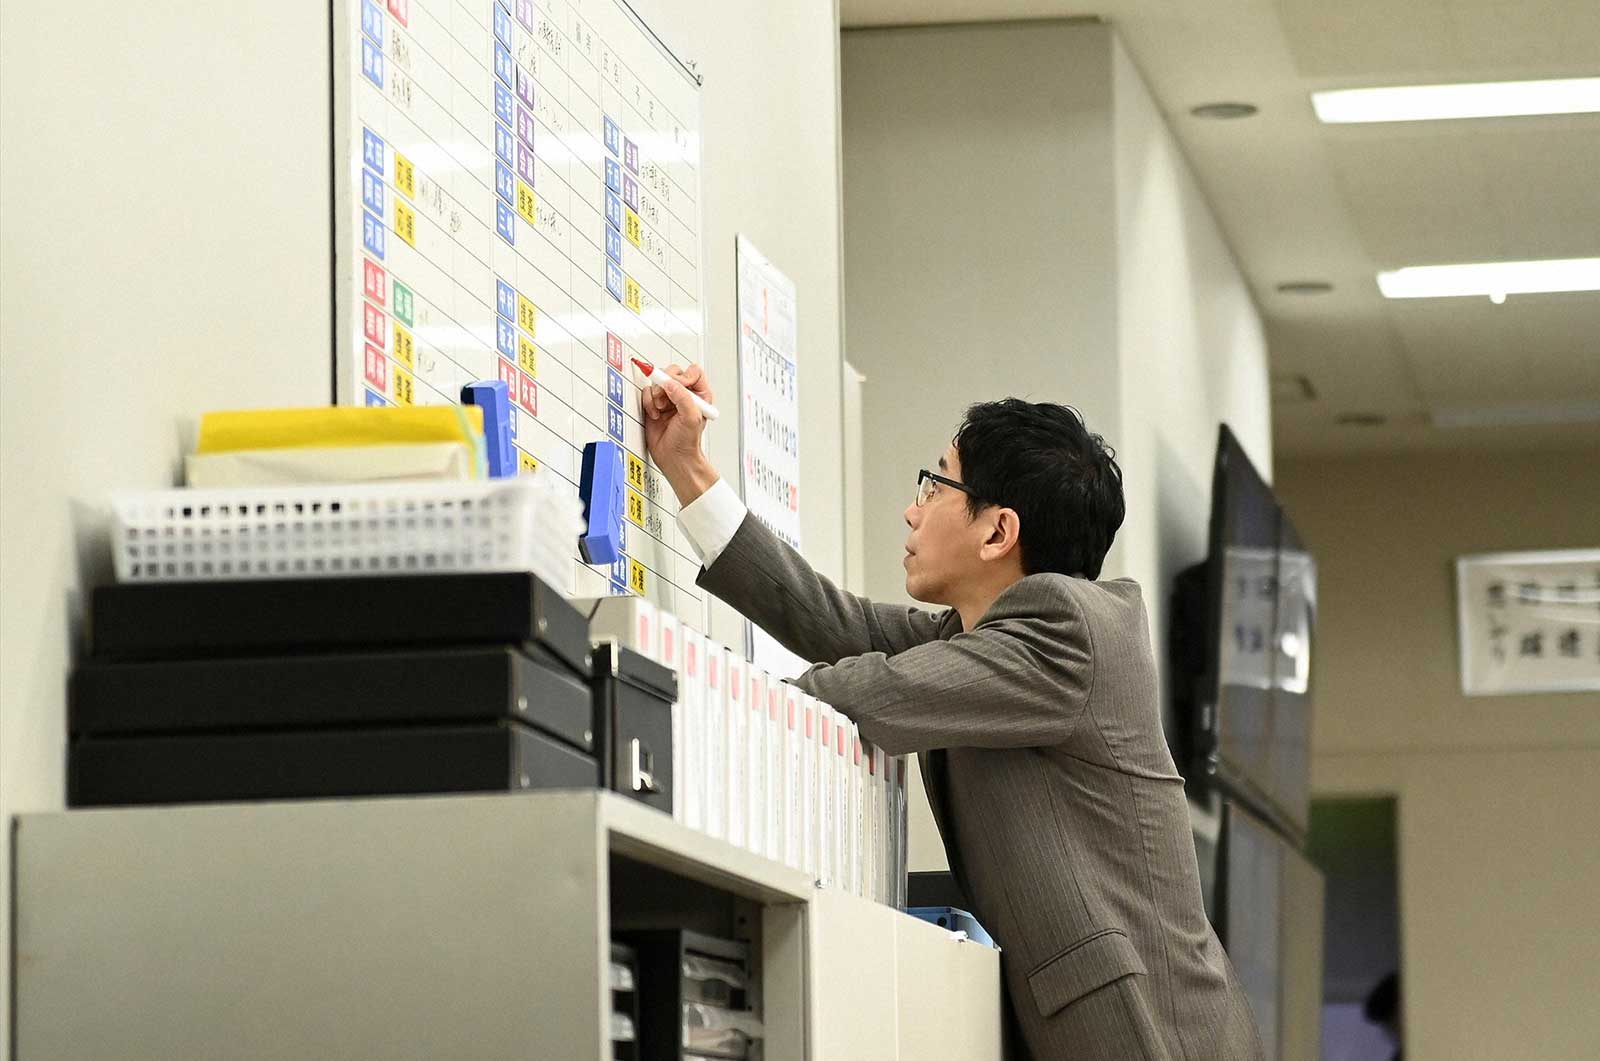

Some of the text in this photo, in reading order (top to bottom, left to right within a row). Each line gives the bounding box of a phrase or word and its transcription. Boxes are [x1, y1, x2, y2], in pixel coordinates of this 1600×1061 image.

[497, 87, 512, 120] 三宅
[498, 166, 512, 198] 山本
[610, 373, 622, 401] 田中
